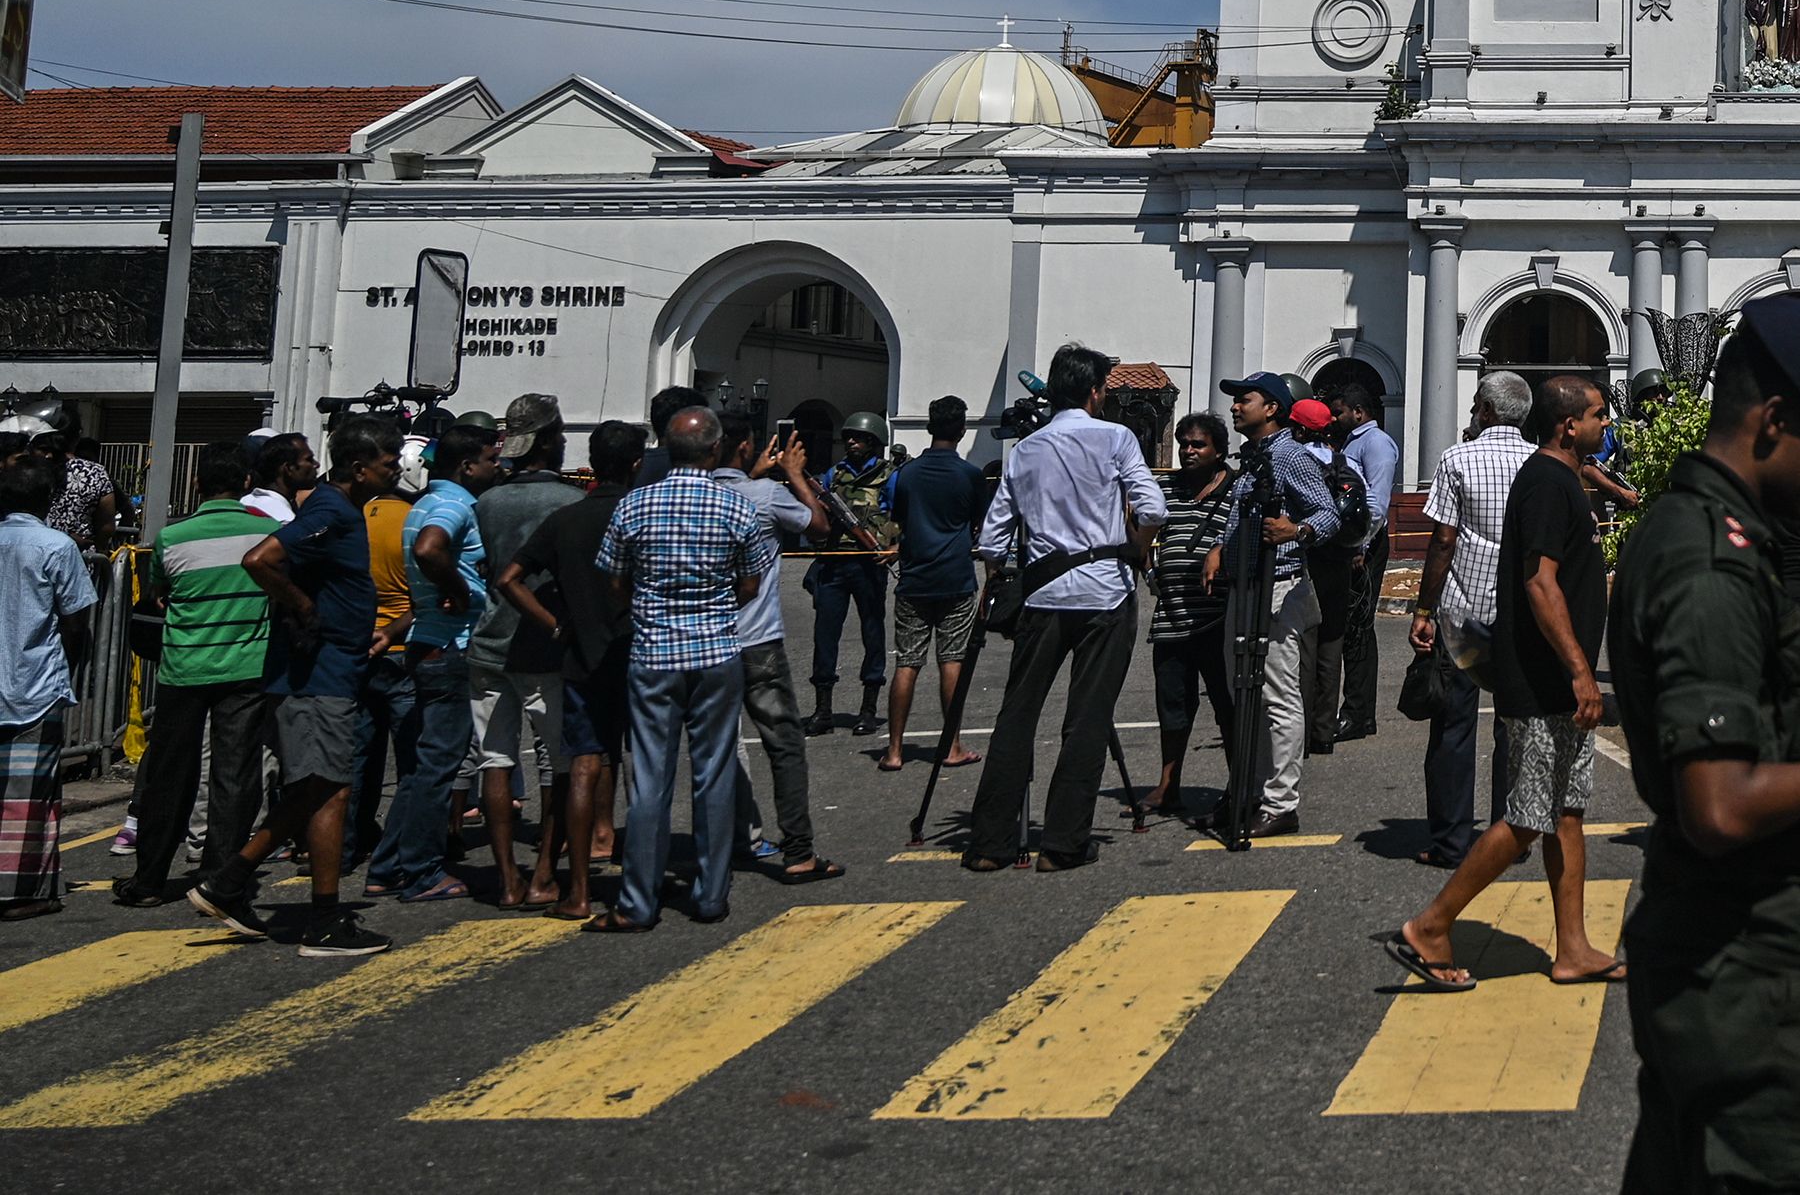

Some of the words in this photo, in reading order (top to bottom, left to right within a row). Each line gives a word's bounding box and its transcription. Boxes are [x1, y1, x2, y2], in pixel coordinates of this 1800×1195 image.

[366, 287, 398, 307] ST.
[540, 286, 626, 308] SHRINE
[528, 340, 545, 357] 13
